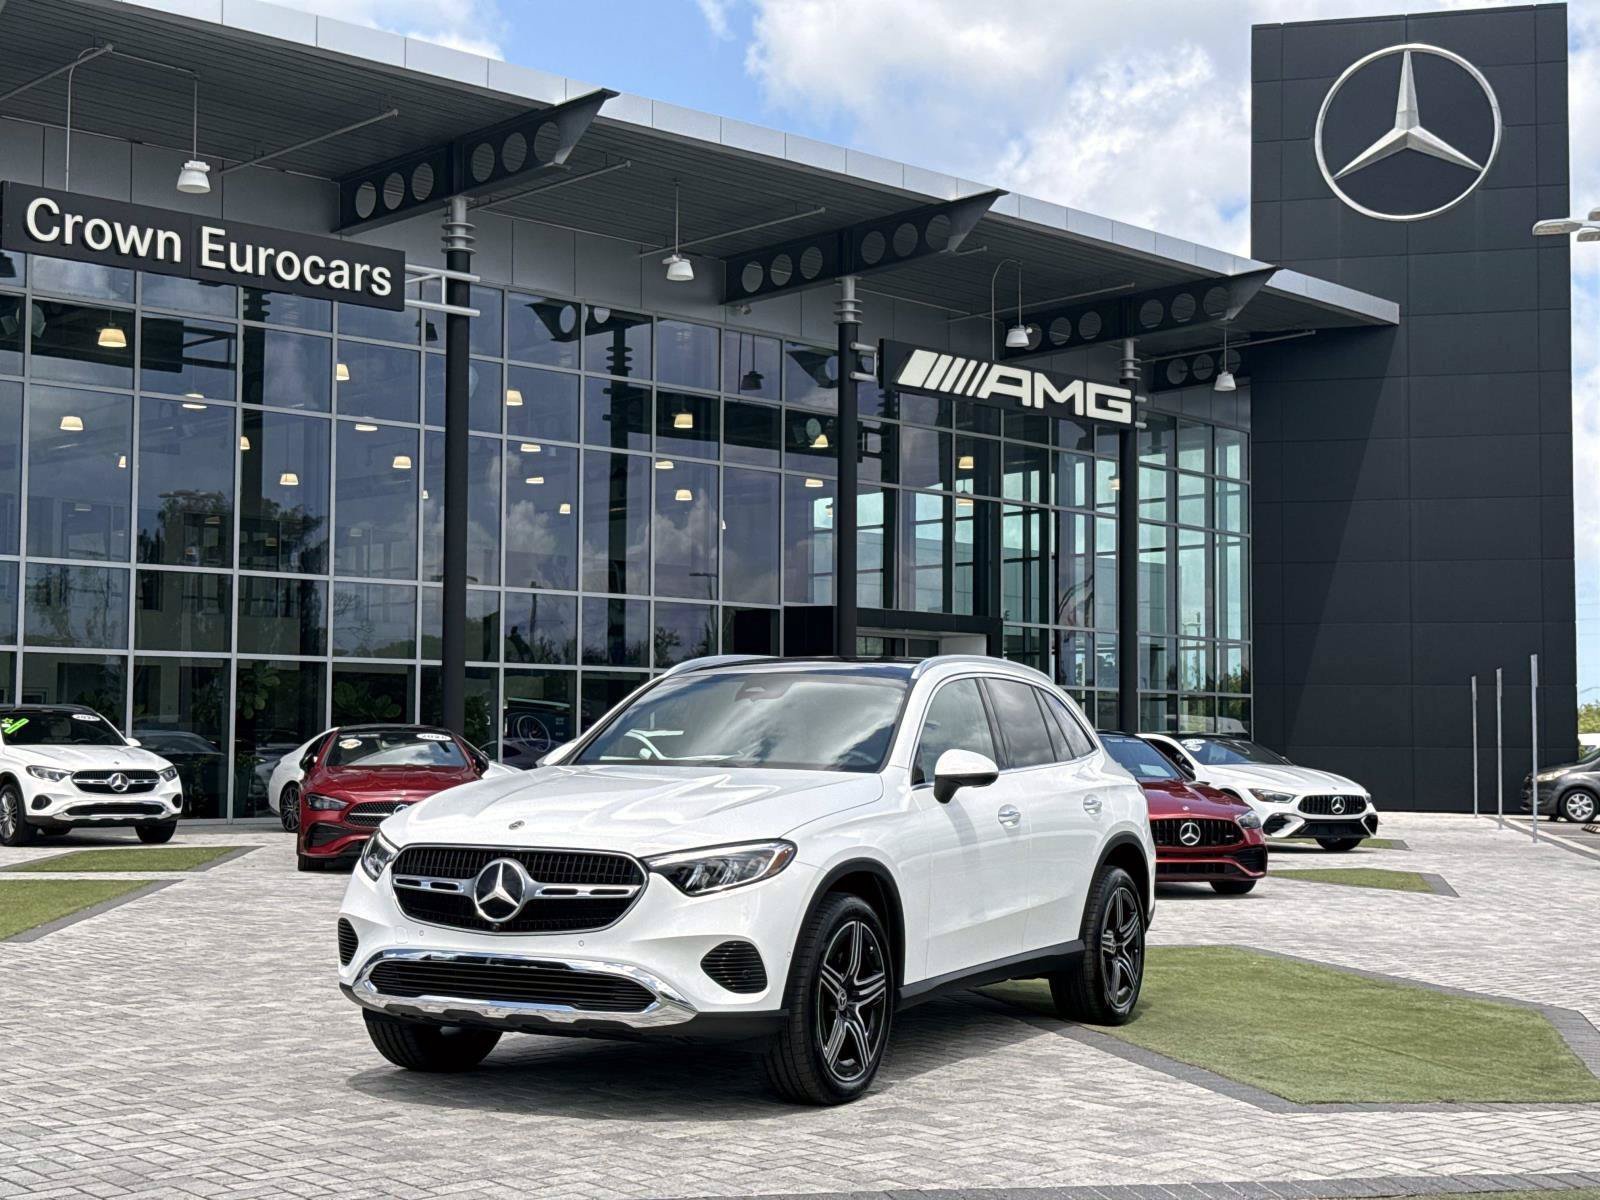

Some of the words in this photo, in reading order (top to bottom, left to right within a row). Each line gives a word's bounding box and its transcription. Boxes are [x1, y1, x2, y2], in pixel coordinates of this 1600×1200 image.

[25, 197, 182, 263] Crown
[200, 226, 393, 297] Eurocars
[977, 363, 1132, 424] AMG
